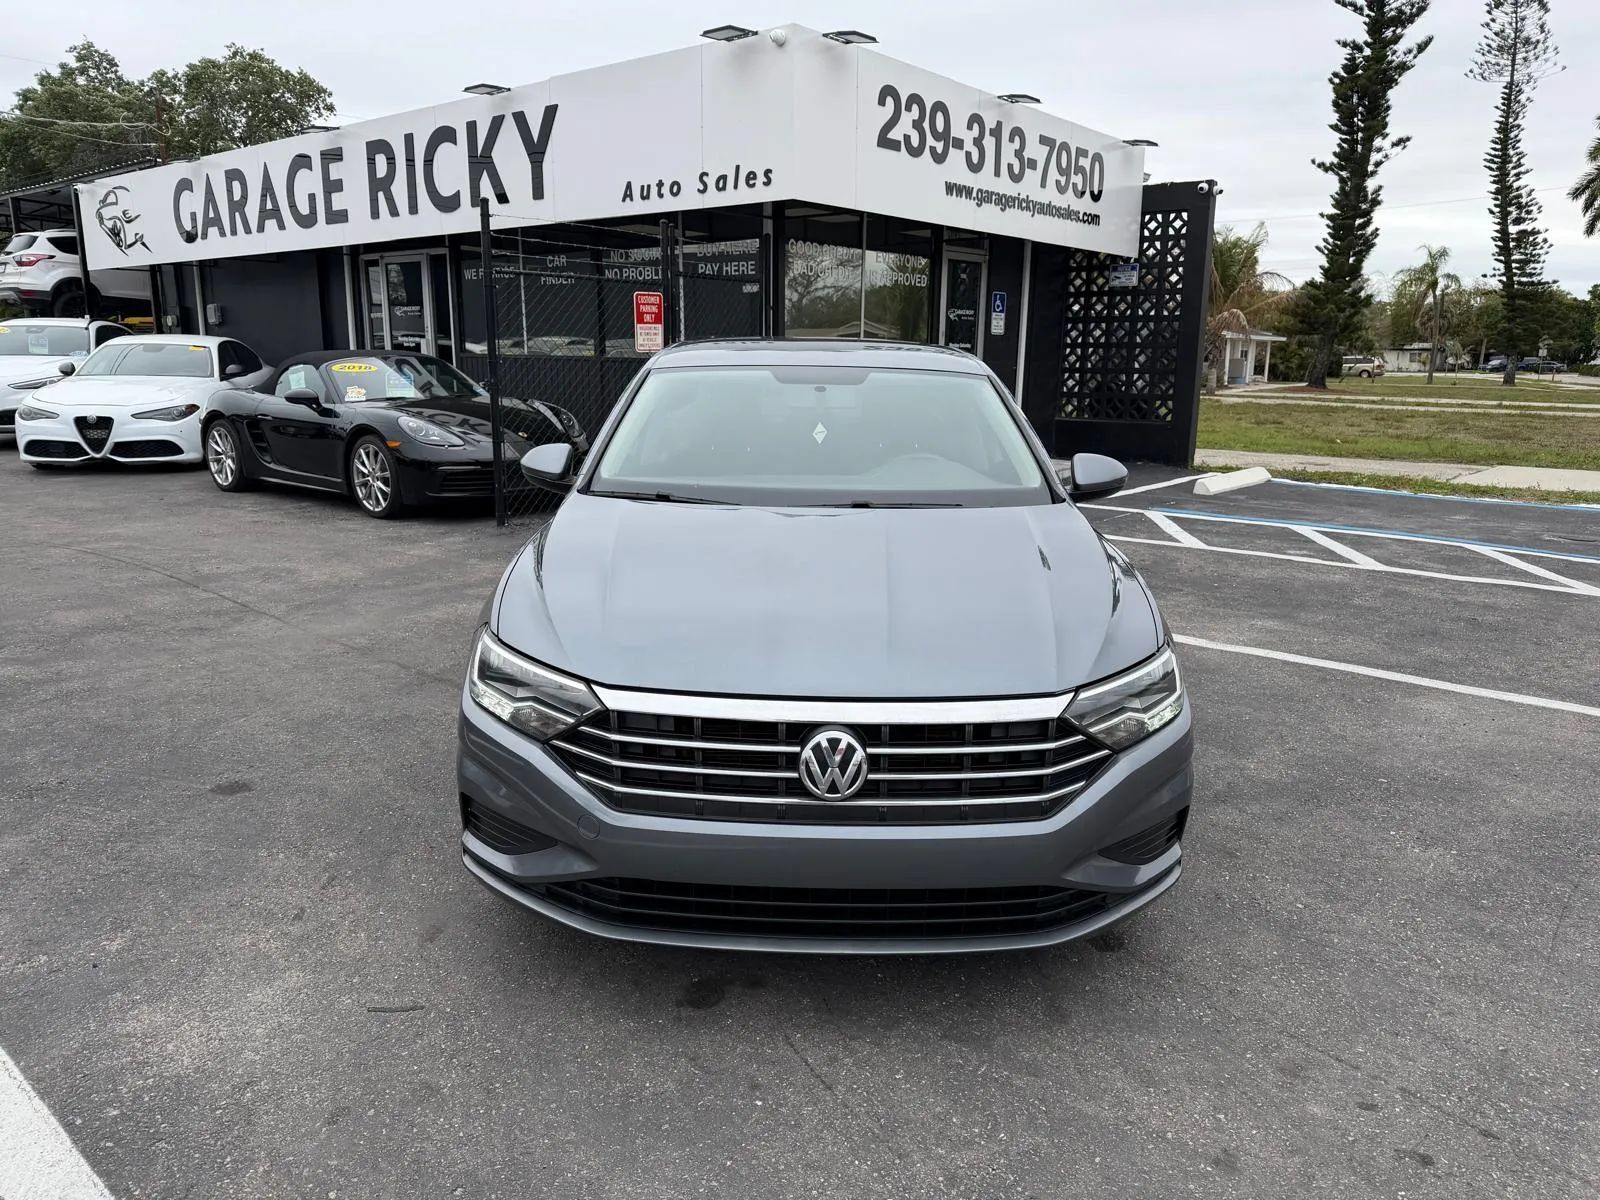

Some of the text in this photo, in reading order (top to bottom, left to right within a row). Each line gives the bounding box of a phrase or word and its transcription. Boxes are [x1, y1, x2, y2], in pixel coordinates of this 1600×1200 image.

[876, 84, 1105, 203] 239-313-7950
[172, 103, 559, 244] GARAGE RICKY
[621, 164, 773, 203] Auto Sales
[944, 180, 1101, 227] www.garagerickyautosales.com
[788, 238, 820, 256] GOOD
[546, 254, 567, 268] CAR
[628, 248, 664, 261] SOCIA
[463, 268, 477, 280] WE
[604, 268, 620, 279] NO
[698, 260, 756, 276] PAY HERE
[637, 295, 660, 304] CUSTOMER
[639, 304, 659, 313] PARKING
[643, 313, 655, 323] ONLY
